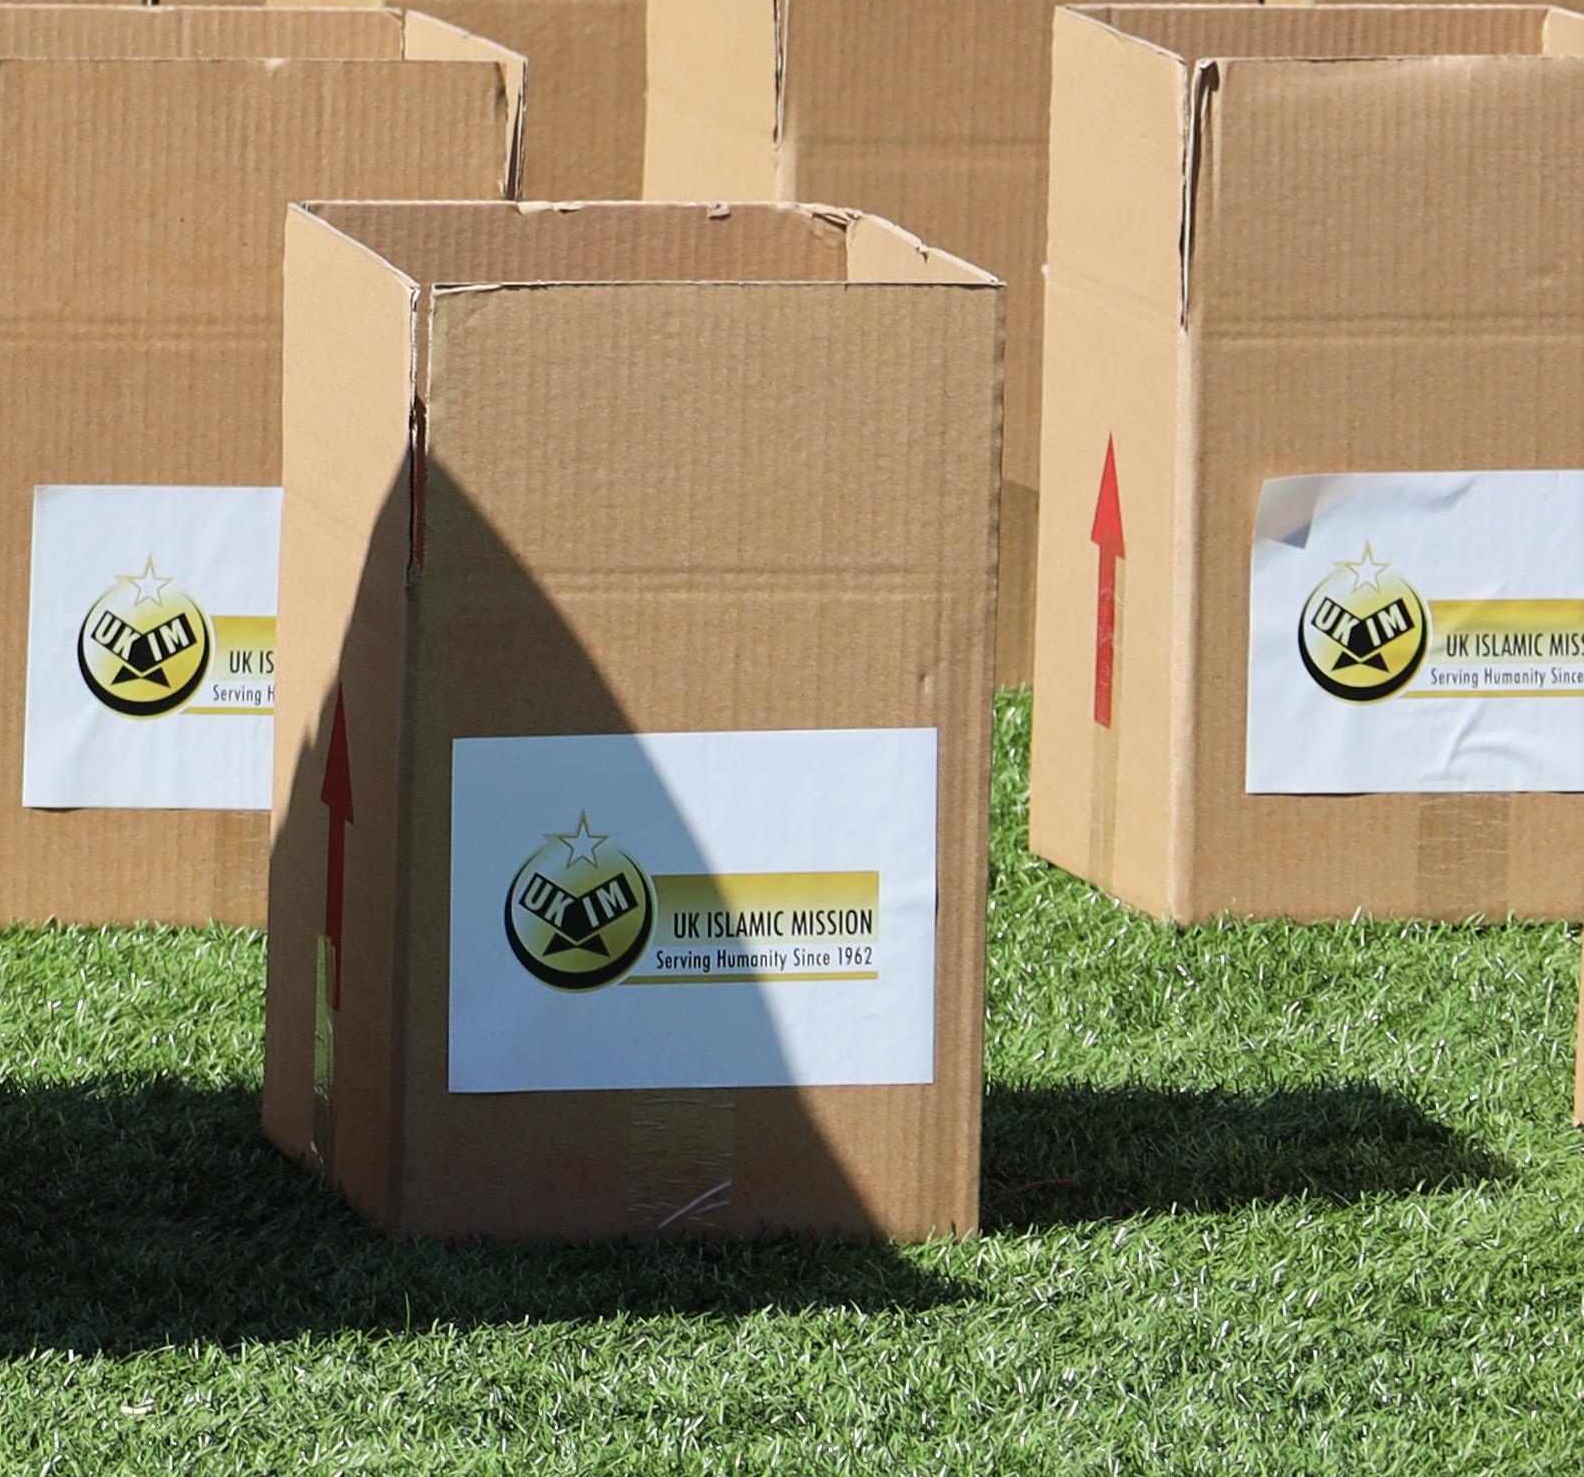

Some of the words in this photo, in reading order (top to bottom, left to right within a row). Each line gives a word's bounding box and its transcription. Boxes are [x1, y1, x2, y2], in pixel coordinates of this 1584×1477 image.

[1315, 600, 1409, 648] UKIM
[96, 614, 190, 663] UKIM
[1446, 633, 1470, 658] UK
[1475, 632, 1544, 657] ISLAMIC
[1549, 632, 1584, 656] MISS
[229, 650, 253, 674] UK
[1431, 668, 1479, 689] Serving
[1484, 667, 1546, 688] Humanity
[1551, 667, 1584, 685] Since
[213, 684, 262, 706] Serving
[524, 876, 630, 929] UKIM
[673, 911, 701, 940] UK
[707, 910, 784, 939] ISLAMIC
[790, 908, 872, 936] MISSION
[656, 948, 711, 974] Serving
[716, 947, 788, 973] Humanity
[793, 947, 830, 967] Since
[838, 946, 873, 966] 1962
